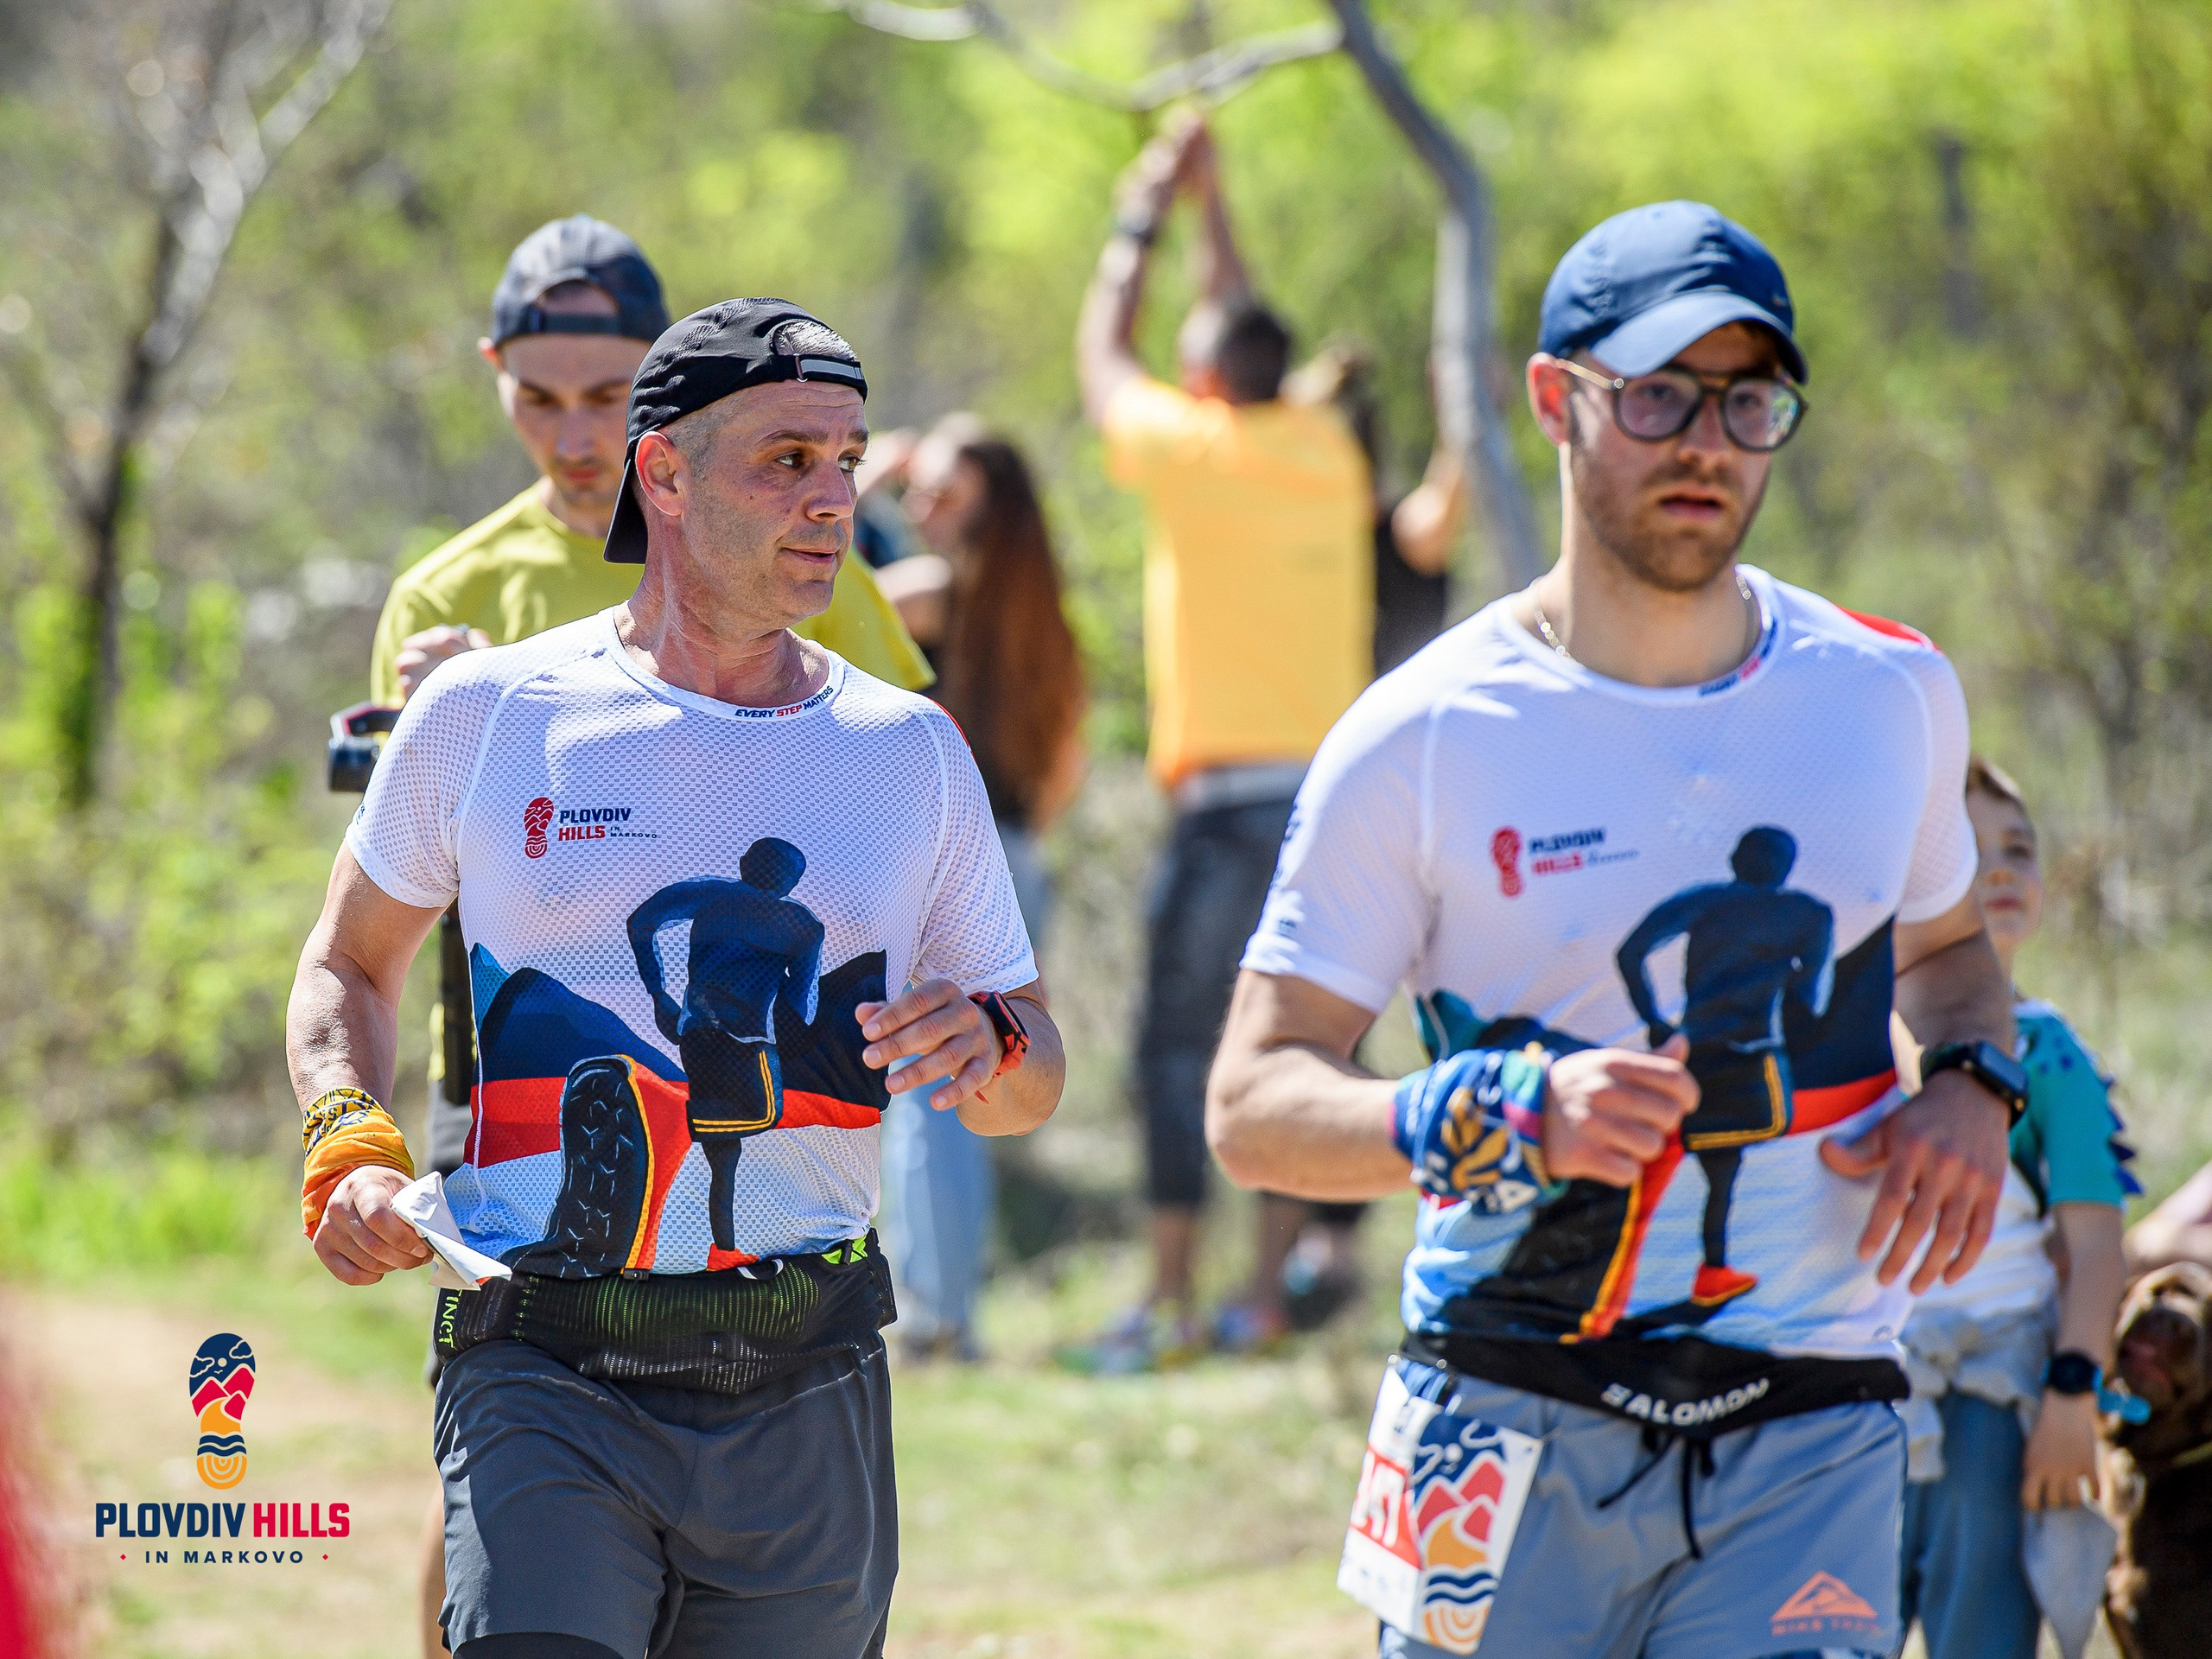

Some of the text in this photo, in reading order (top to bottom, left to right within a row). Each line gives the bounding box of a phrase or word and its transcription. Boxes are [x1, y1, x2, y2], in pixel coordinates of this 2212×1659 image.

[734, 685, 834, 718] EVERY STEP MATTERS
[560, 808, 632, 824] PLOVDIV
[558, 825, 606, 842] HILLS
[1600, 1377, 1770, 1427] SALOMON
